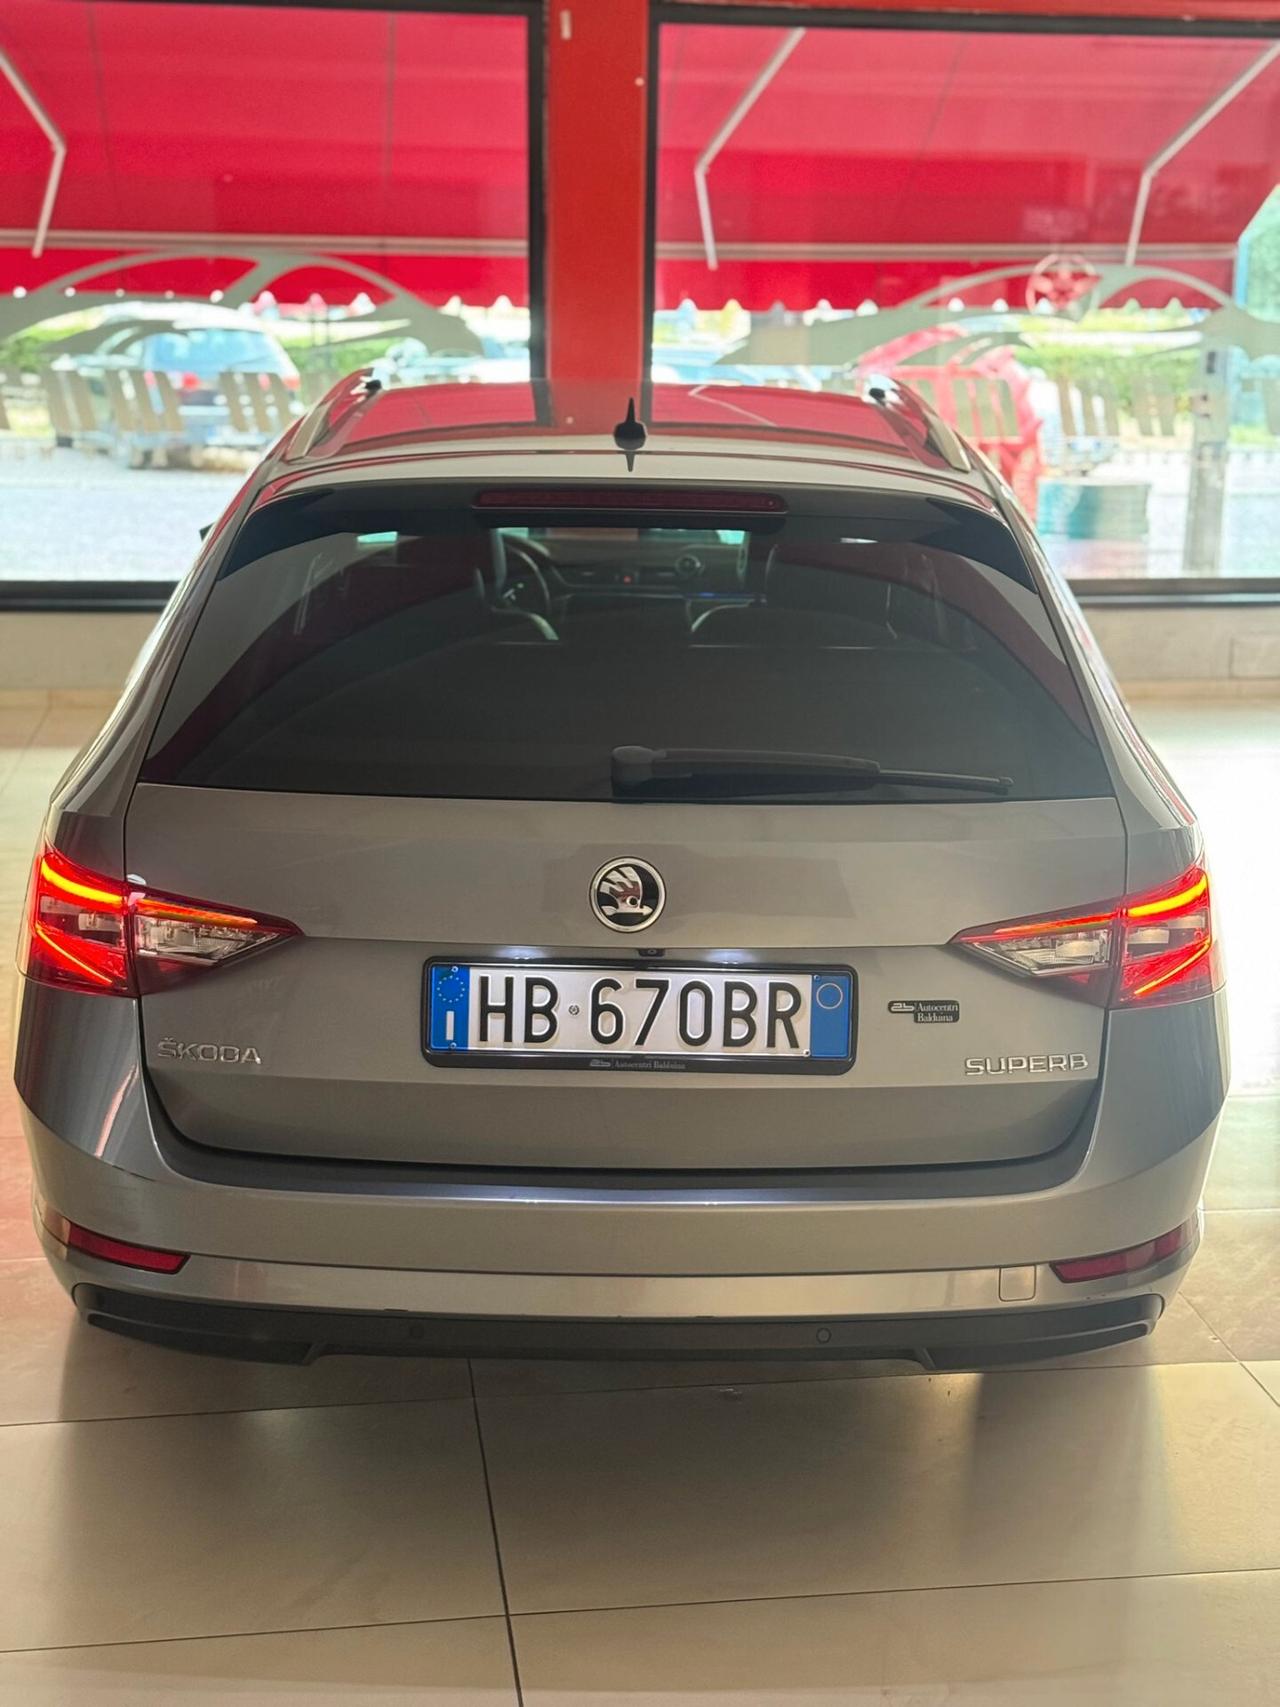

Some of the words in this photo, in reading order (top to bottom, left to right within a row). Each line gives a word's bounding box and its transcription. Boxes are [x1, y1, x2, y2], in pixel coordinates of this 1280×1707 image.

[479, 976, 559, 1043] HB
[590, 978, 802, 1048] 670BR
[917, 1013, 954, 1022] Balduina
[918, 1003, 959, 1012] Autocentri
[157, 1037, 262, 1065] ŠKODA
[965, 1053, 1089, 1076] SUPERB
